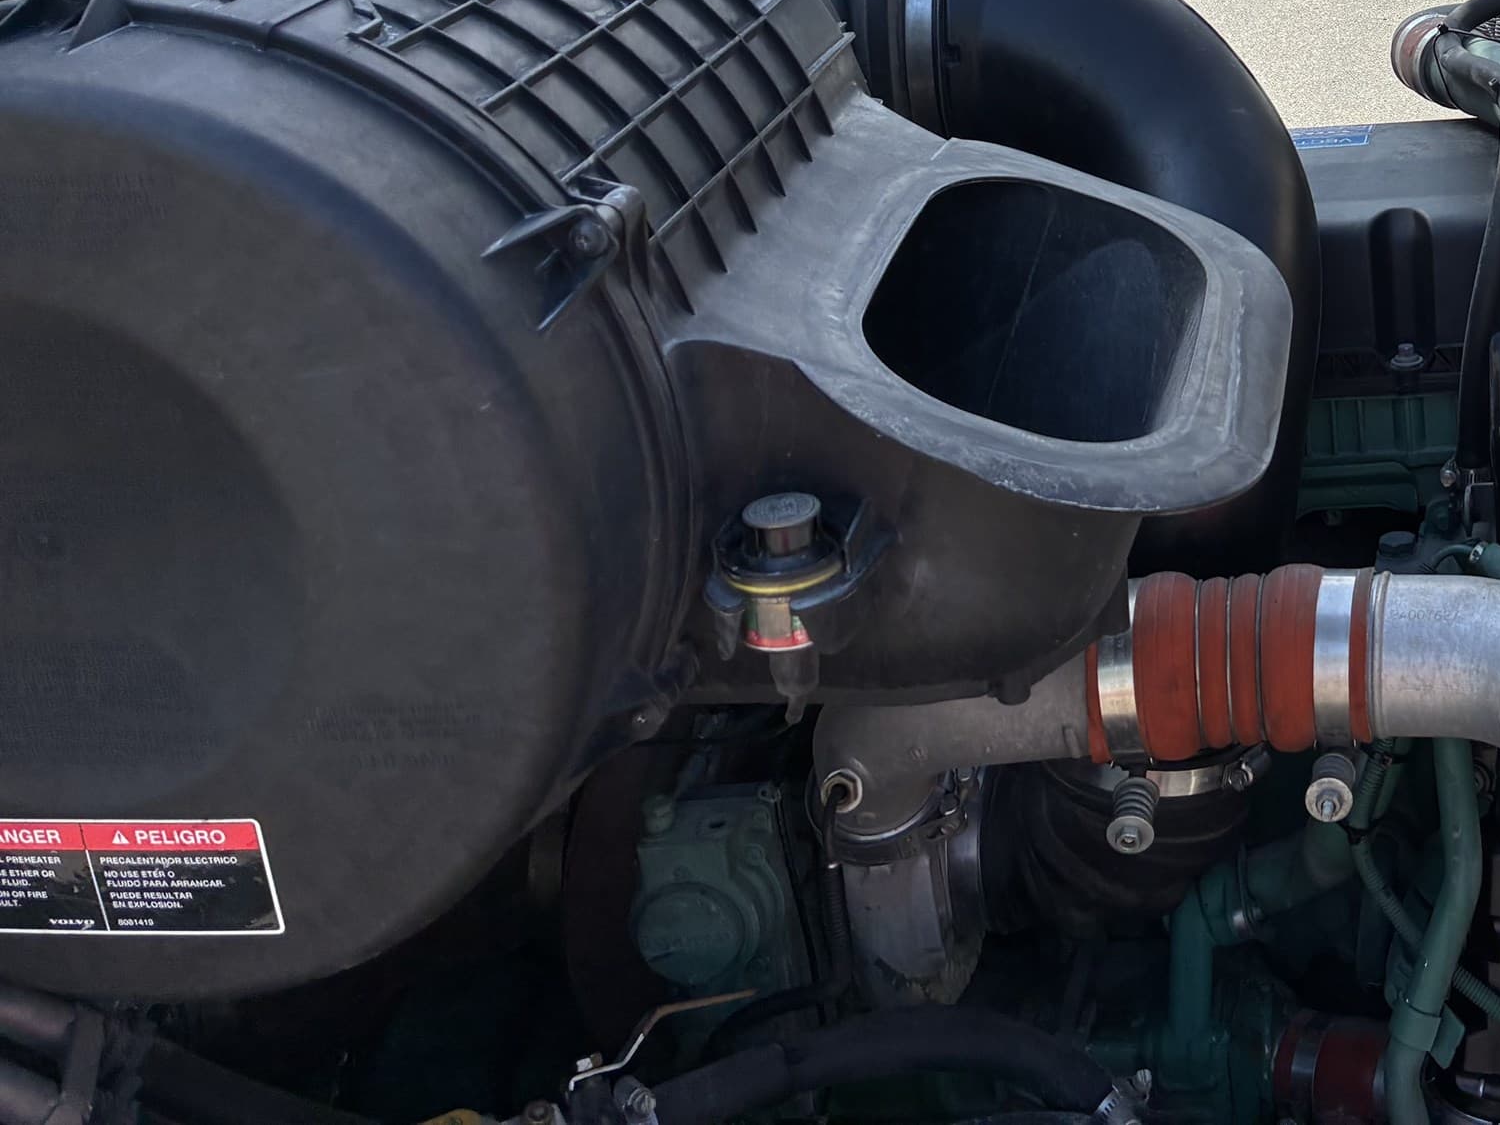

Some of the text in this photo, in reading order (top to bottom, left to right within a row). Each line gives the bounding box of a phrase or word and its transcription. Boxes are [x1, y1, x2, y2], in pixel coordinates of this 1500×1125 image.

[135, 829, 226, 845] PELIGRO
[5, 855, 62, 865] PREHEATER
[99, 856, 238, 866] PRECALENTADOR ELECTRICO
[9, 869, 40, 878] ETHER
[41, 869, 56, 879] OR
[104, 870, 119, 879] NO
[120, 870, 140, 879] USE
[167, 870, 176, 879] O
[2, 878, 31, 887] FLUID.
[107, 879, 225, 888] FLUIDO PARA ARRANCAR.
[11, 890, 26, 899] OR
[27, 890, 48, 899] FIRE
[110, 891, 193, 901] PUEDE RESULTAR
[113, 901, 183, 910] EN EXPLOSION.
